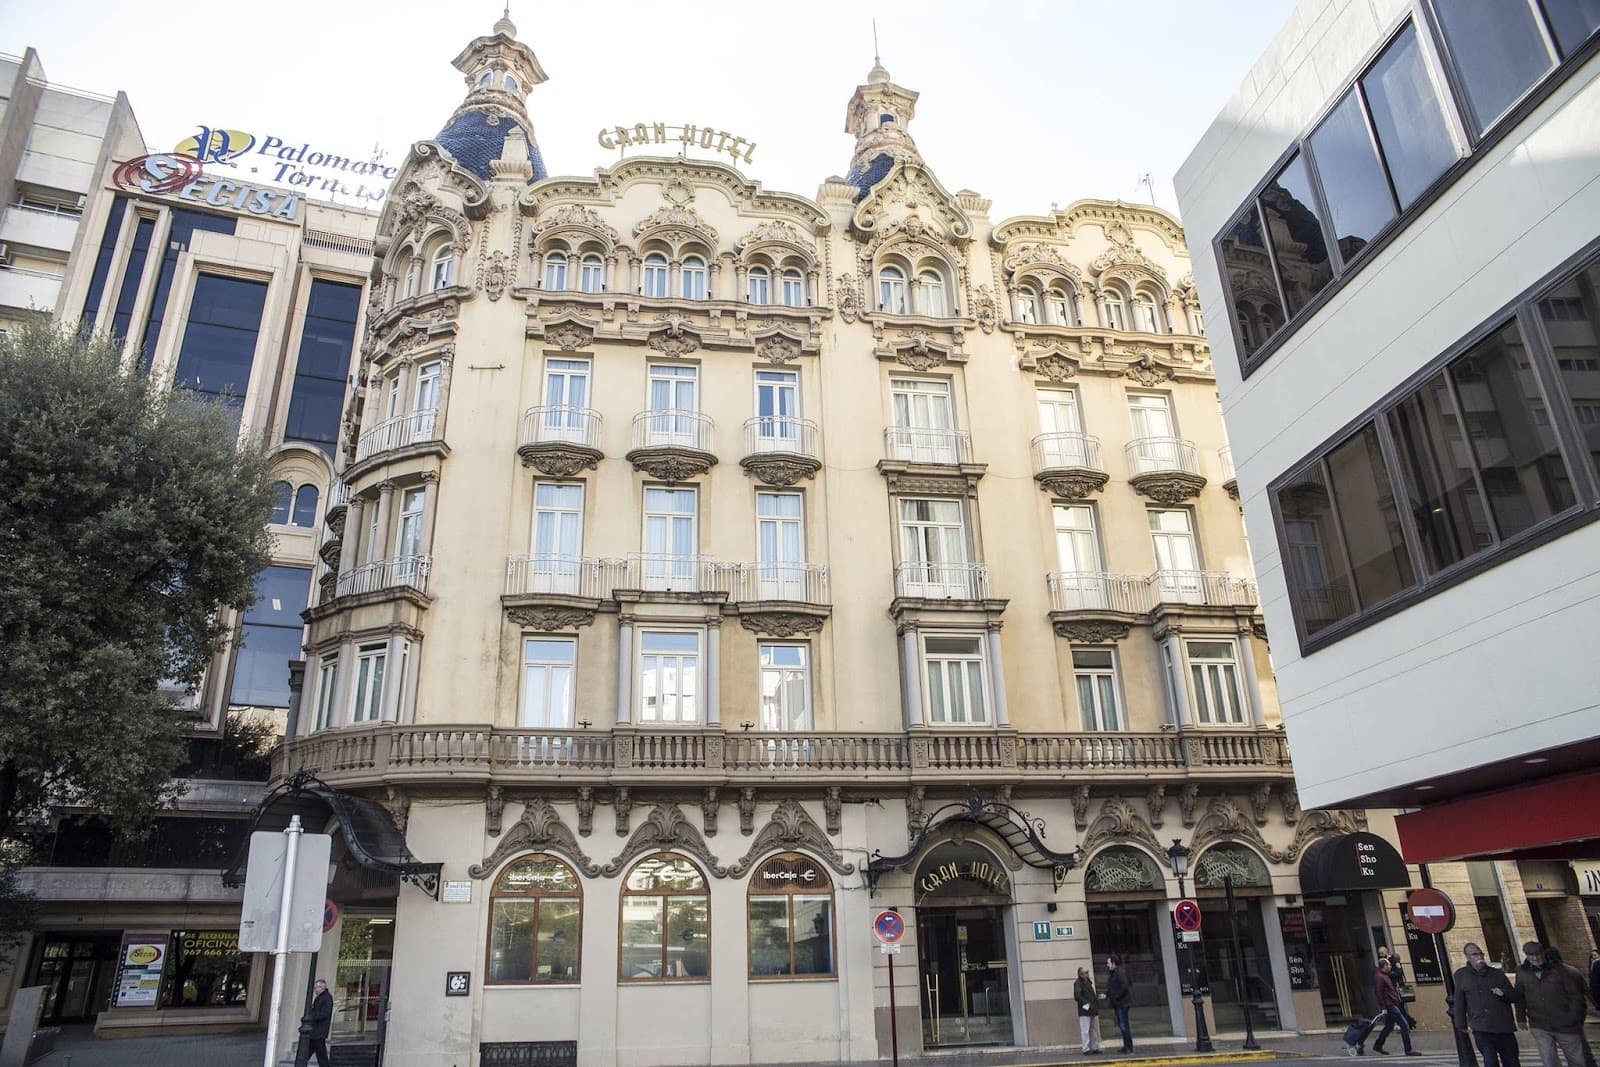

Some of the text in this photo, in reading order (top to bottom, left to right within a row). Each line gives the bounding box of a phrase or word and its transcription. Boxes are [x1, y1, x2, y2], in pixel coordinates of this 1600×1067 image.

[597, 121, 757, 165] GRAN HOTEL
[139, 154, 299, 220] SECISA
[1358, 842, 1375, 851] Sen
[1360, 854, 1377, 864] Sho
[921, 860, 1009, 892] GRAN HOTEL
[1362, 867, 1375, 876] Ku
[184, 940, 238, 948] OFICINA
